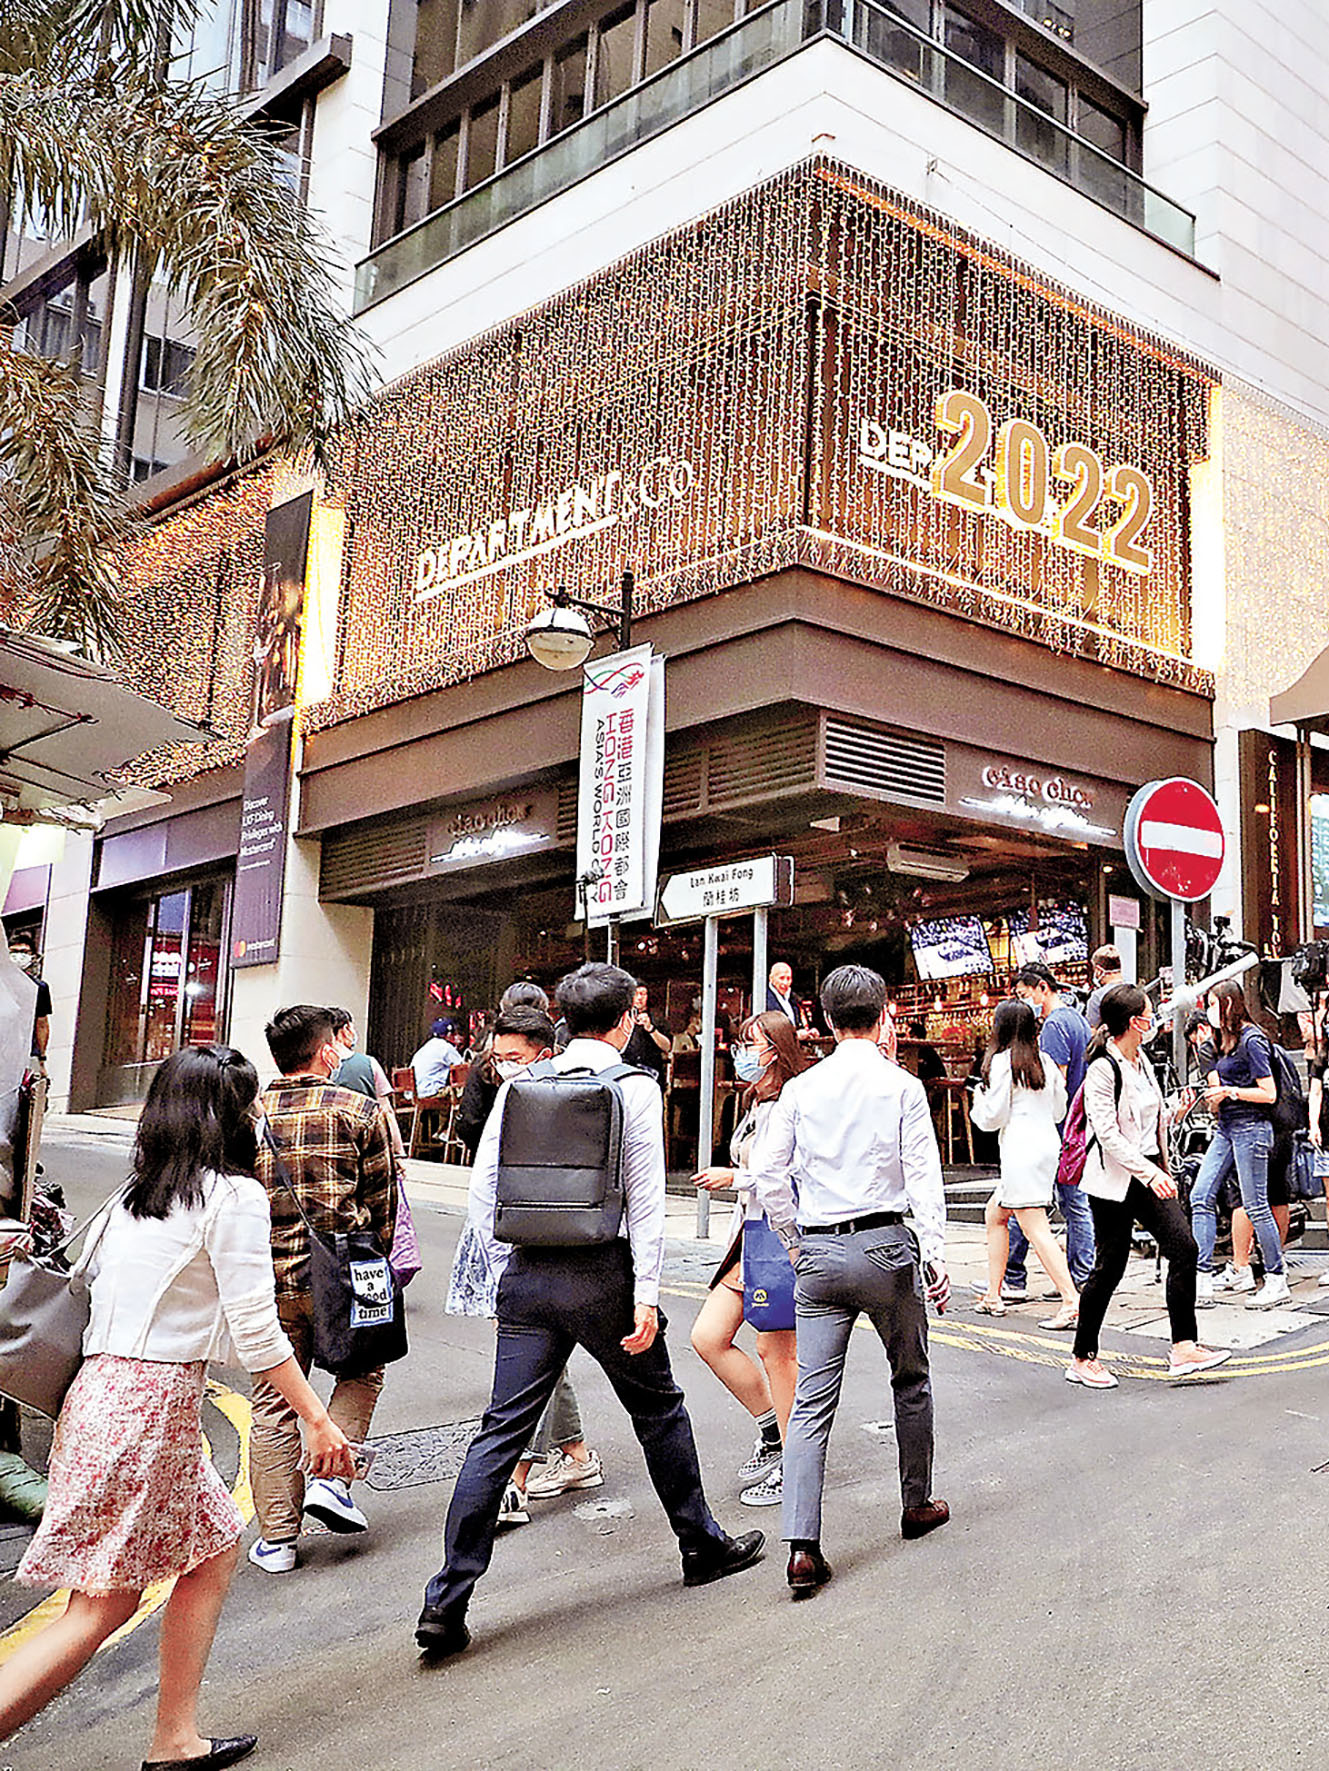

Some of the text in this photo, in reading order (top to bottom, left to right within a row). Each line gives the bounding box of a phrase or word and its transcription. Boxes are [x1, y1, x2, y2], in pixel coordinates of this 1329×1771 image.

[935, 390, 1151, 575] 2022
[590, 719, 605, 903] ASIA'S WORLD CY
[599, 712, 617, 903] HONG KONG
[1268, 750, 1280, 906] CALIFORNIA
[690, 867, 753, 888] Lan Kwai Fong
[354, 1269, 384, 1281] have
[359, 1307, 387, 1320] time
[367, 1282, 374, 1291] a
